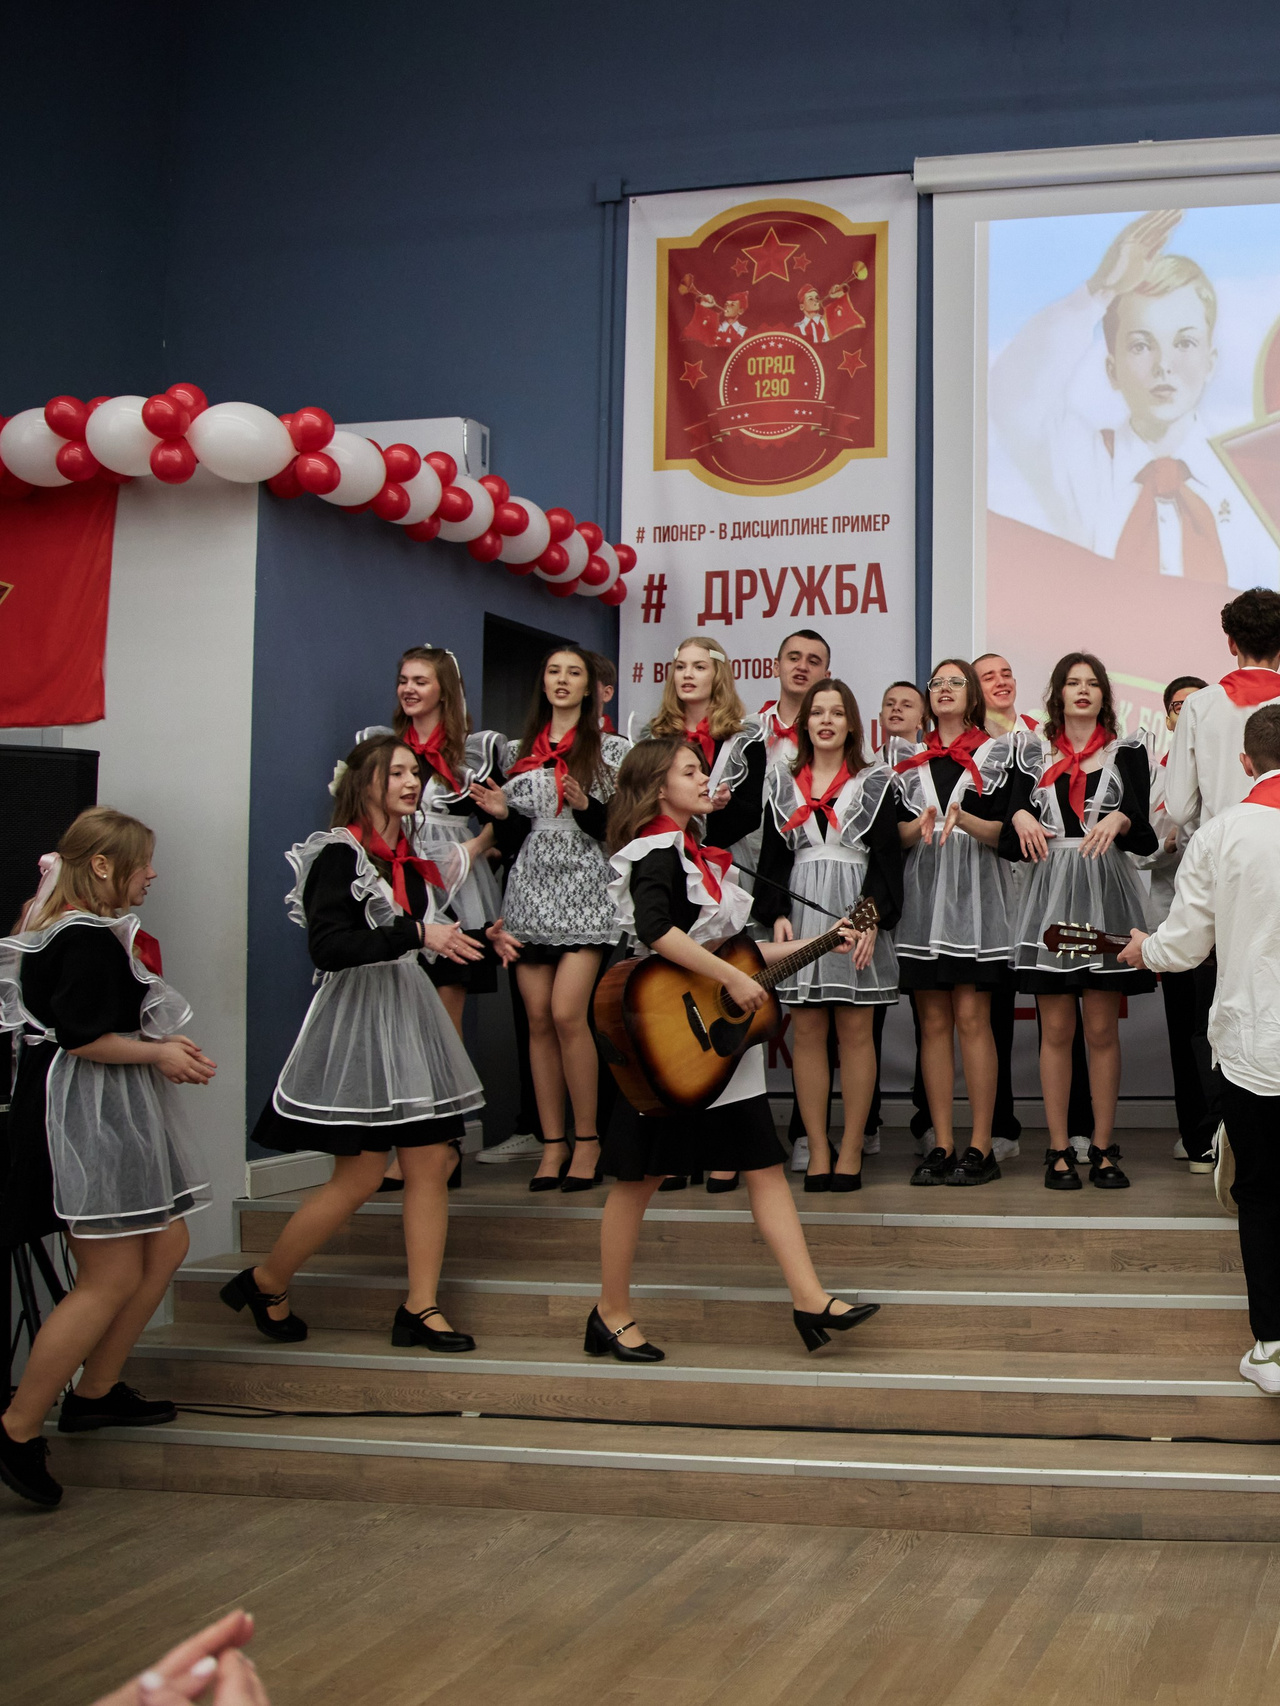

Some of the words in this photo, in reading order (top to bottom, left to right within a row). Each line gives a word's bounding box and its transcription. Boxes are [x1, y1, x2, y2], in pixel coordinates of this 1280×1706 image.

[747, 355, 795, 376] ОТРЯД
[755, 378, 789, 398] 1290
[653, 524, 706, 544] ПИОНЕР
[719, 522, 728, 540] В
[730, 515, 828, 541] ДИСЦИПЛИНЕ
[832, 513, 890, 534] ПРИМЕР
[641, 573, 667, 624] #
[697, 562, 888, 627] ДРУЖБА
[729, 657, 787, 680] ОТОВ
